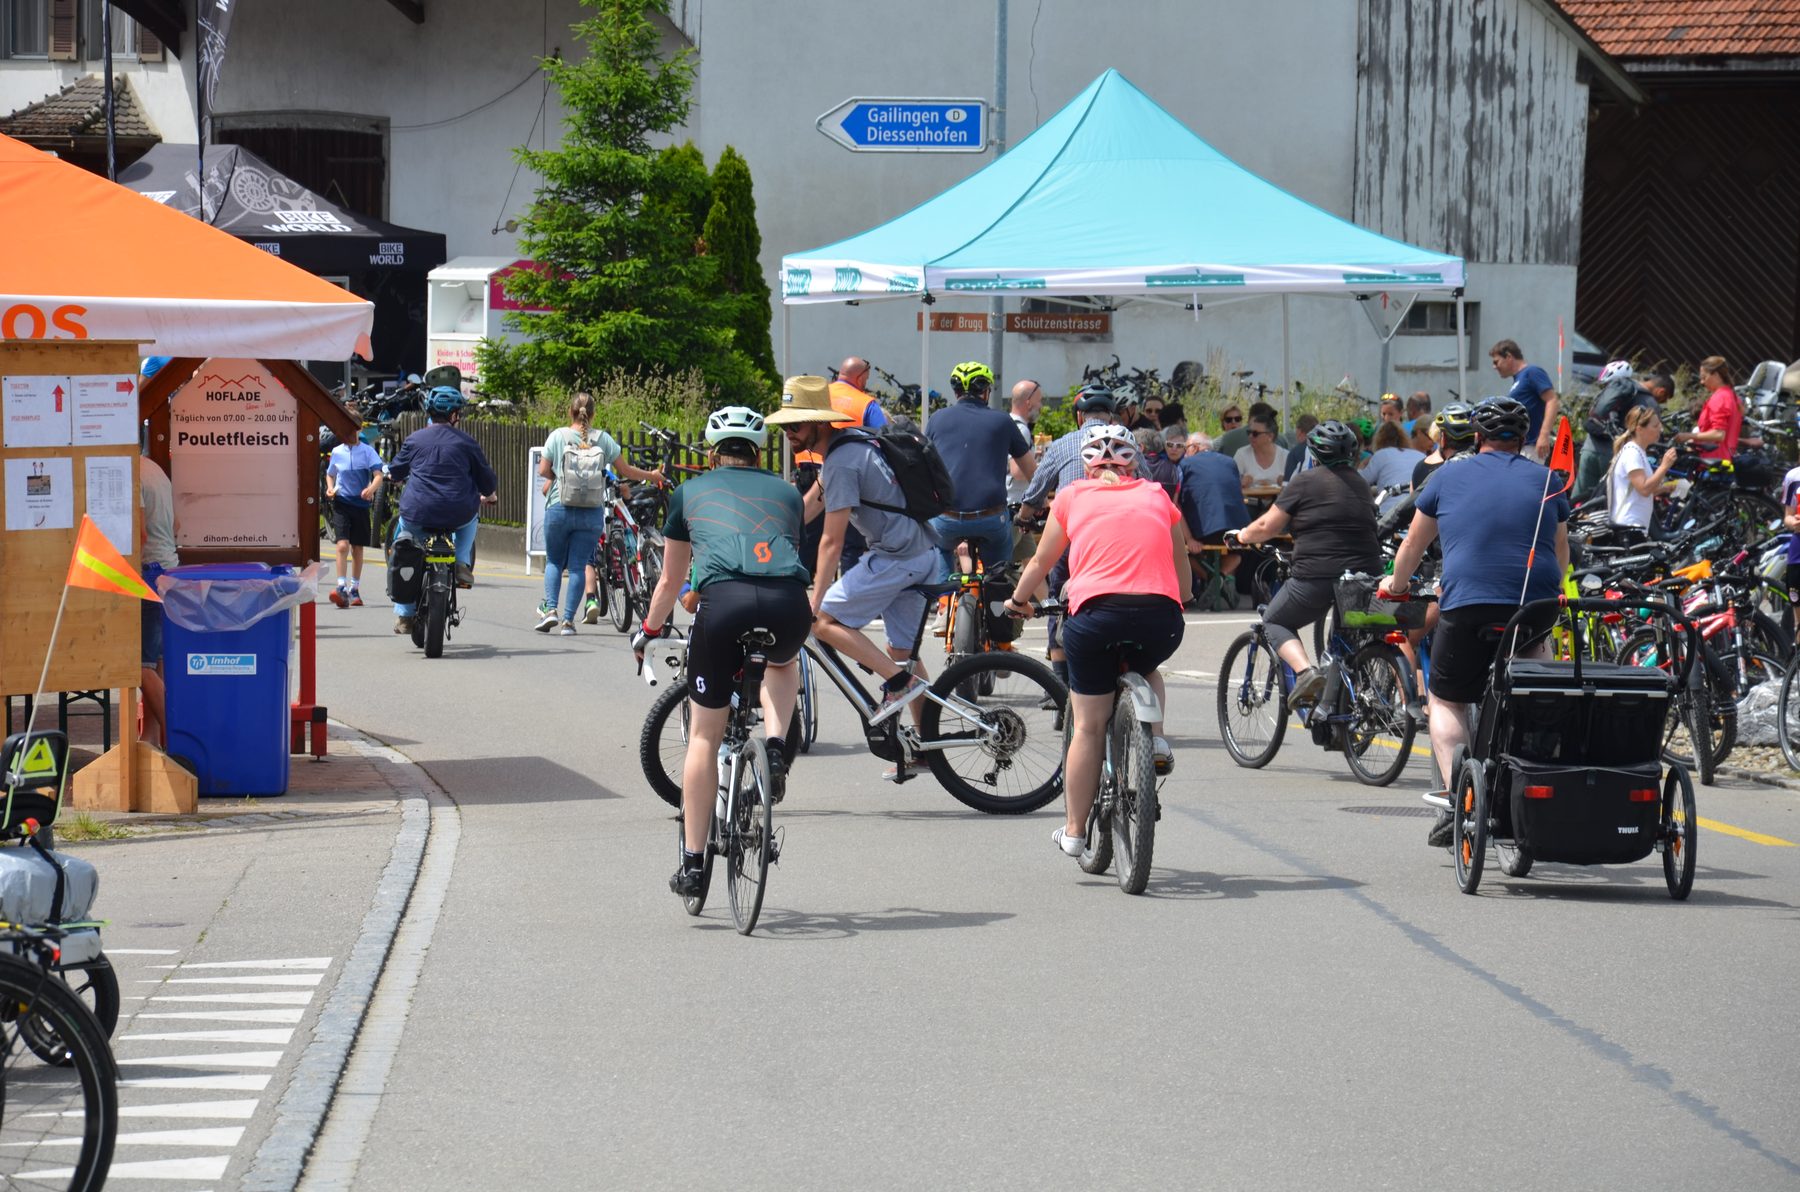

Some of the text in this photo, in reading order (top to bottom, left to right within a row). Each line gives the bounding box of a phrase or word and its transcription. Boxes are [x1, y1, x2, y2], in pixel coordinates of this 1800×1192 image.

[867, 107, 961, 126] Gailingen D
[867, 126, 968, 142] Diessenhofen
[279, 212, 339, 223] BIKE
[263, 223, 352, 233] WORLD
[380, 243, 403, 254] BIKE
[369, 254, 404, 265] WORLD
[940, 316, 954, 329] der
[958, 316, 984, 332] Brugg
[1014, 315, 1102, 330] Schützenstrasse
[206, 391, 261, 402] HOFLADE
[174, 414, 205, 424] Täglich
[223, 414, 246, 422] 07.00
[254, 414, 277, 422] 20.00
[278, 414, 294, 422] Uhr
[178, 431, 289, 446] Pouletfleisch
[203, 534, 268, 543] dihom-dehei.ch
[210, 656, 240, 666] Imhof
